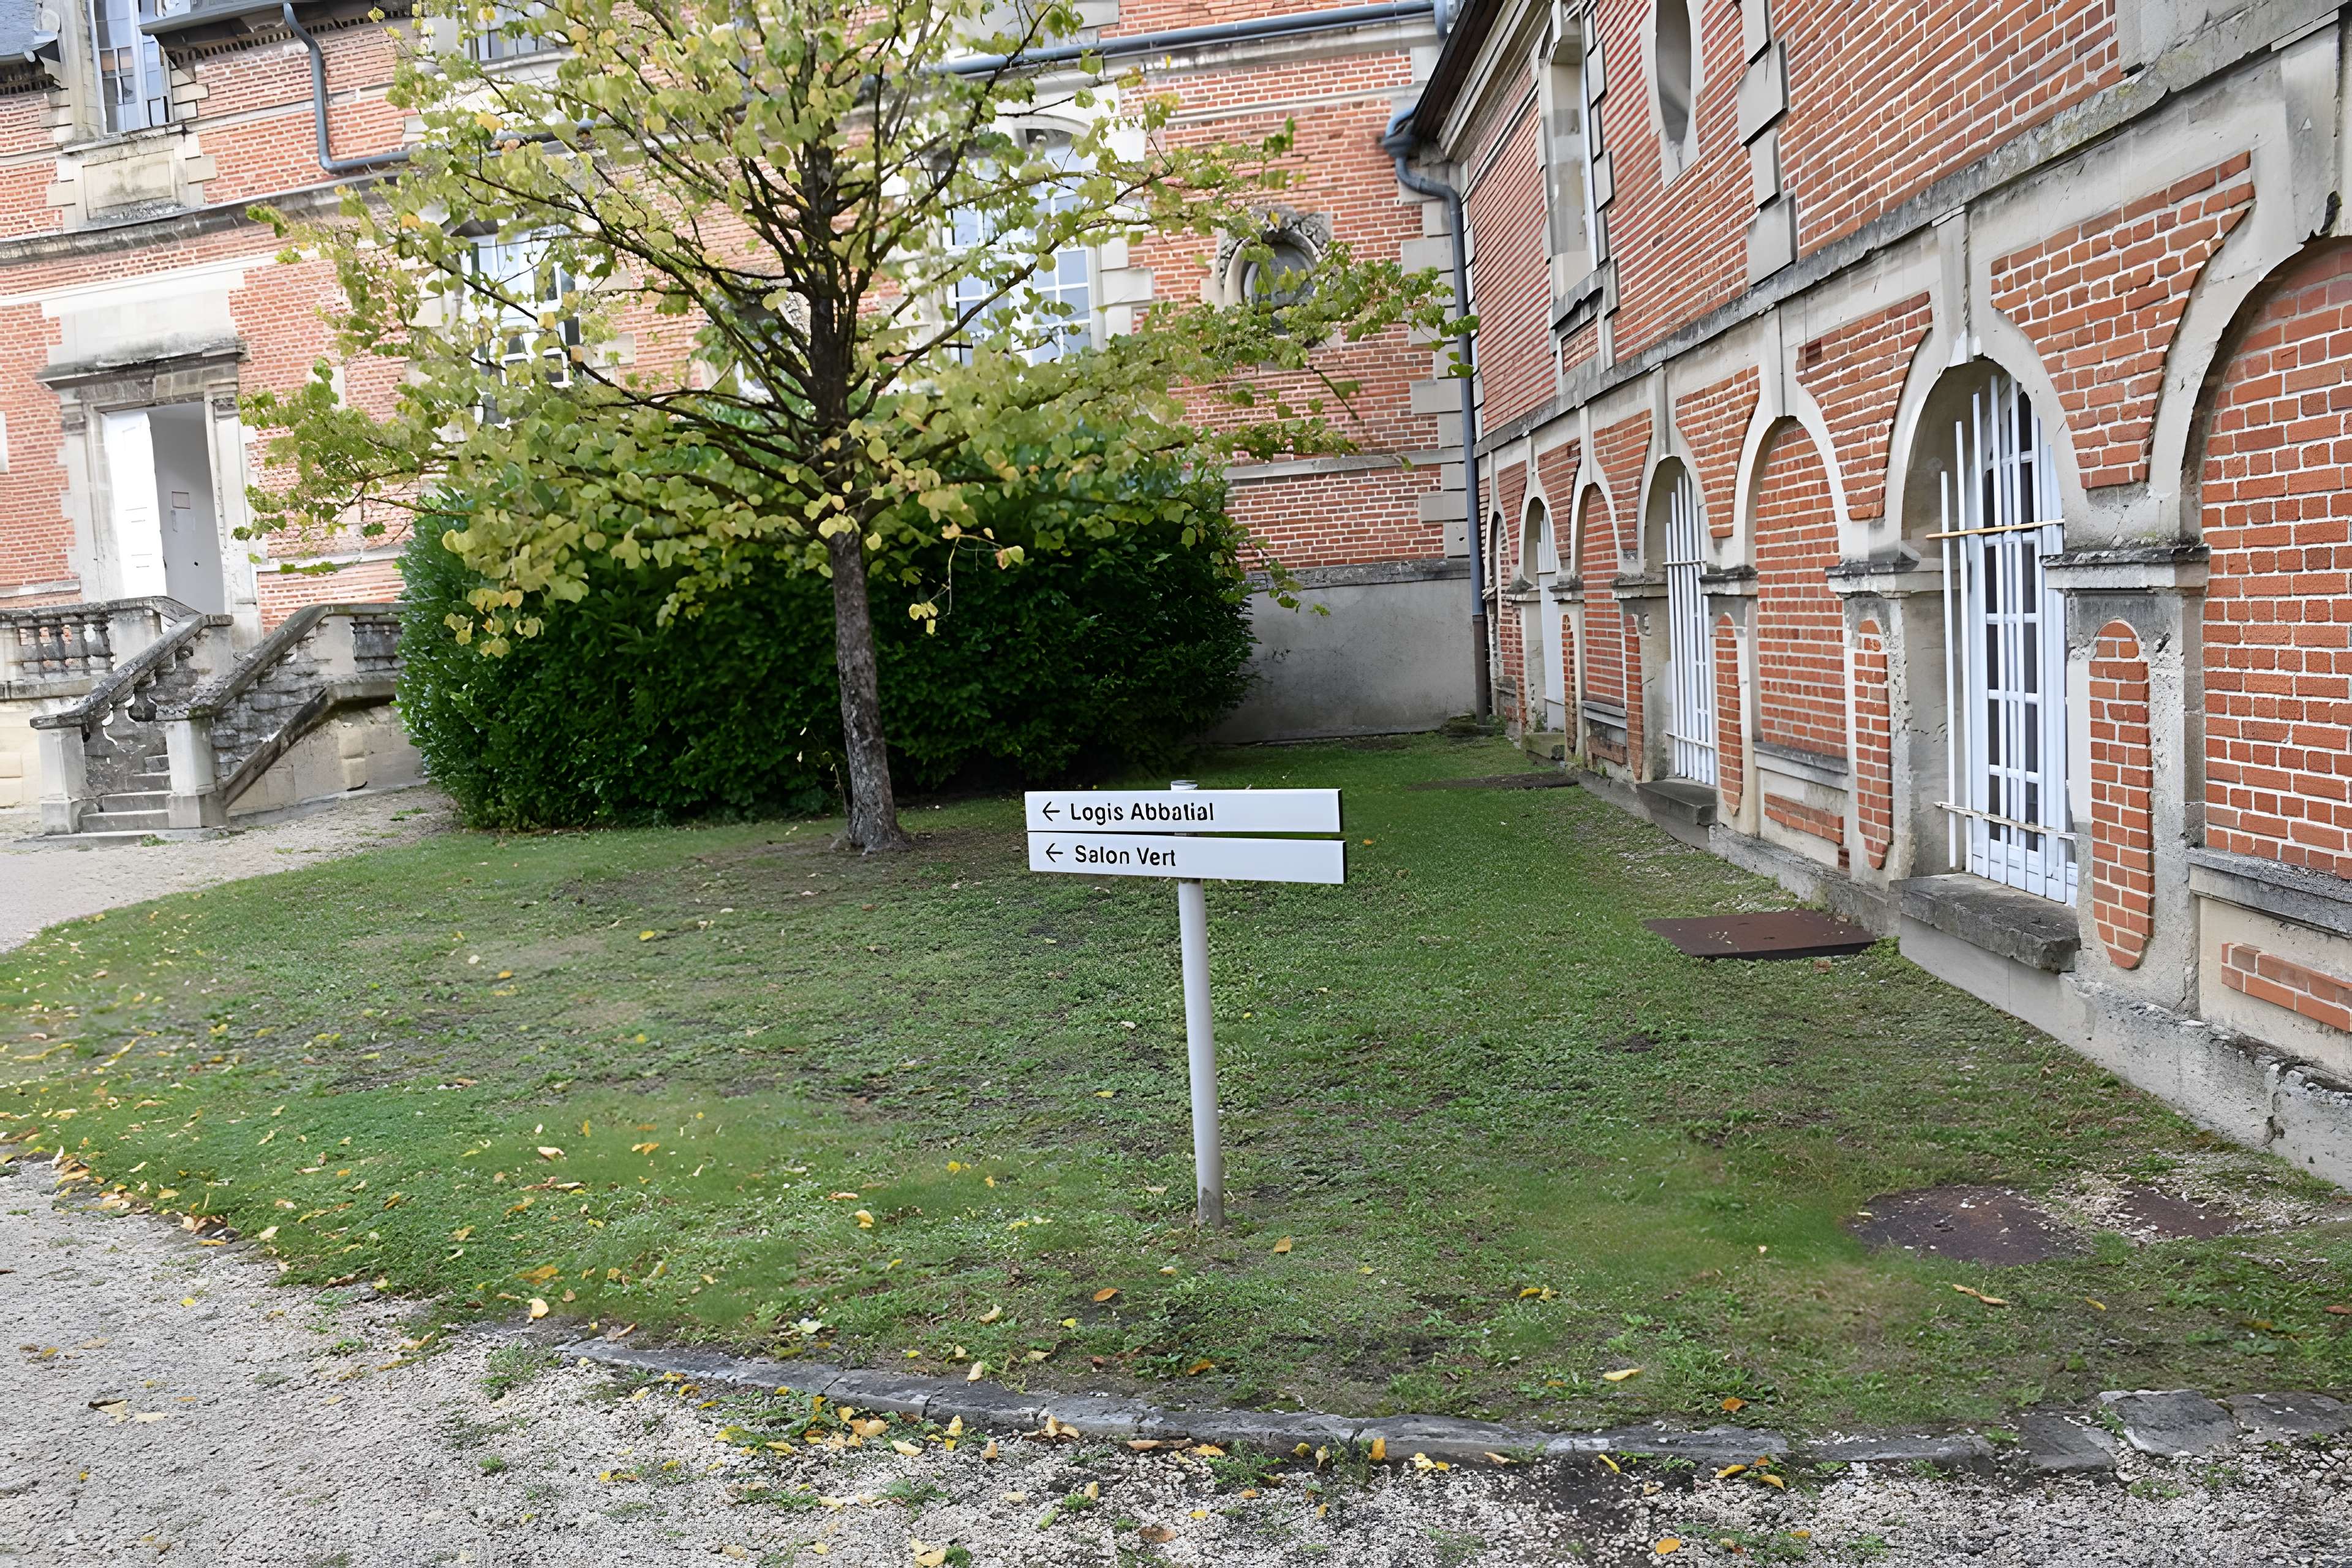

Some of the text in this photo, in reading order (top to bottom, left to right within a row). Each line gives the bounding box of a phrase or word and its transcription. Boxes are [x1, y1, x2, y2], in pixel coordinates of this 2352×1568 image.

[1070, 802, 1214, 826] Logis Abbatial
[1075, 845, 1176, 867] Salon Vert
